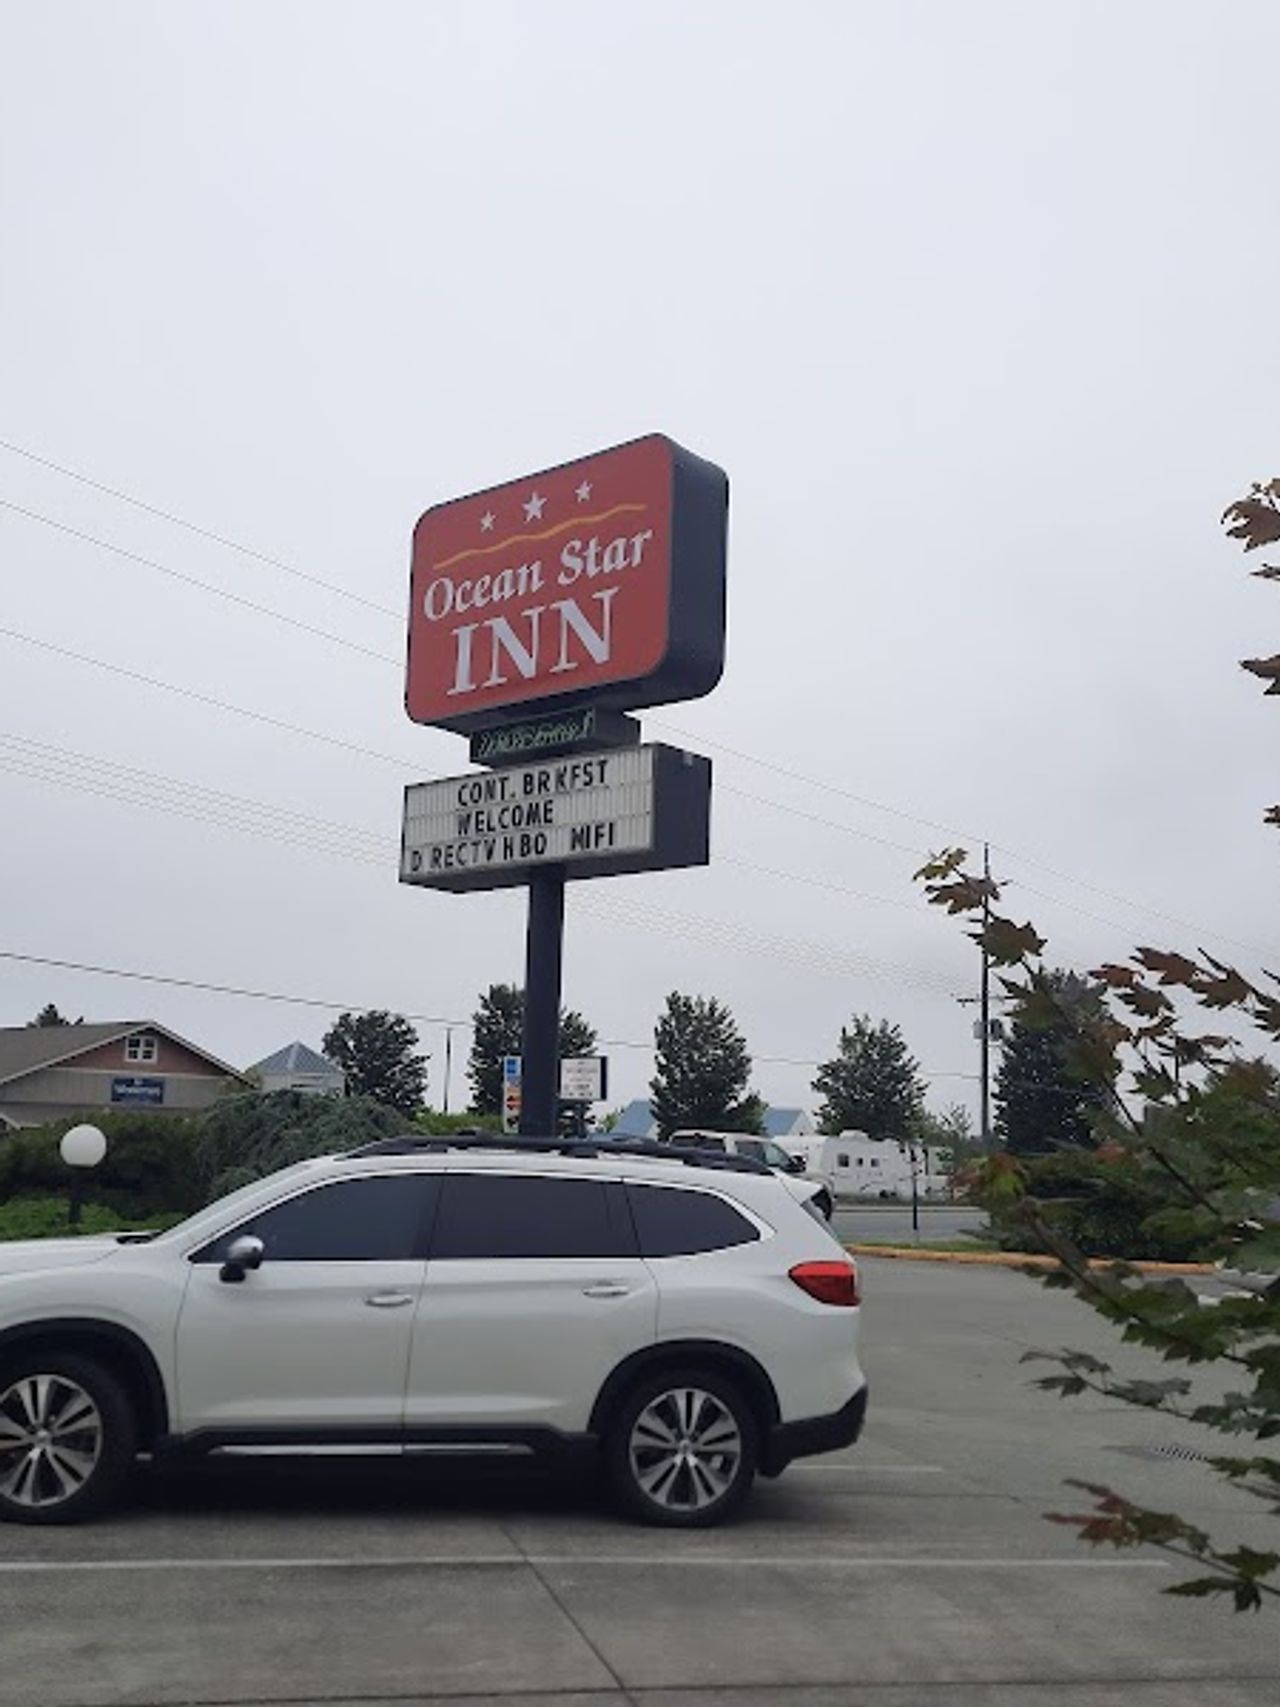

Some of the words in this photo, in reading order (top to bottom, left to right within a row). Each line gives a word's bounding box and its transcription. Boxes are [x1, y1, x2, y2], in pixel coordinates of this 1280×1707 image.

[423, 560, 544, 621] Ocean
[557, 529, 653, 586] Star
[446, 586, 620, 695] INN
[523, 760, 608, 795] BRKFST
[457, 799, 553, 835] WELCOME
[503, 833, 547, 860] HBO
